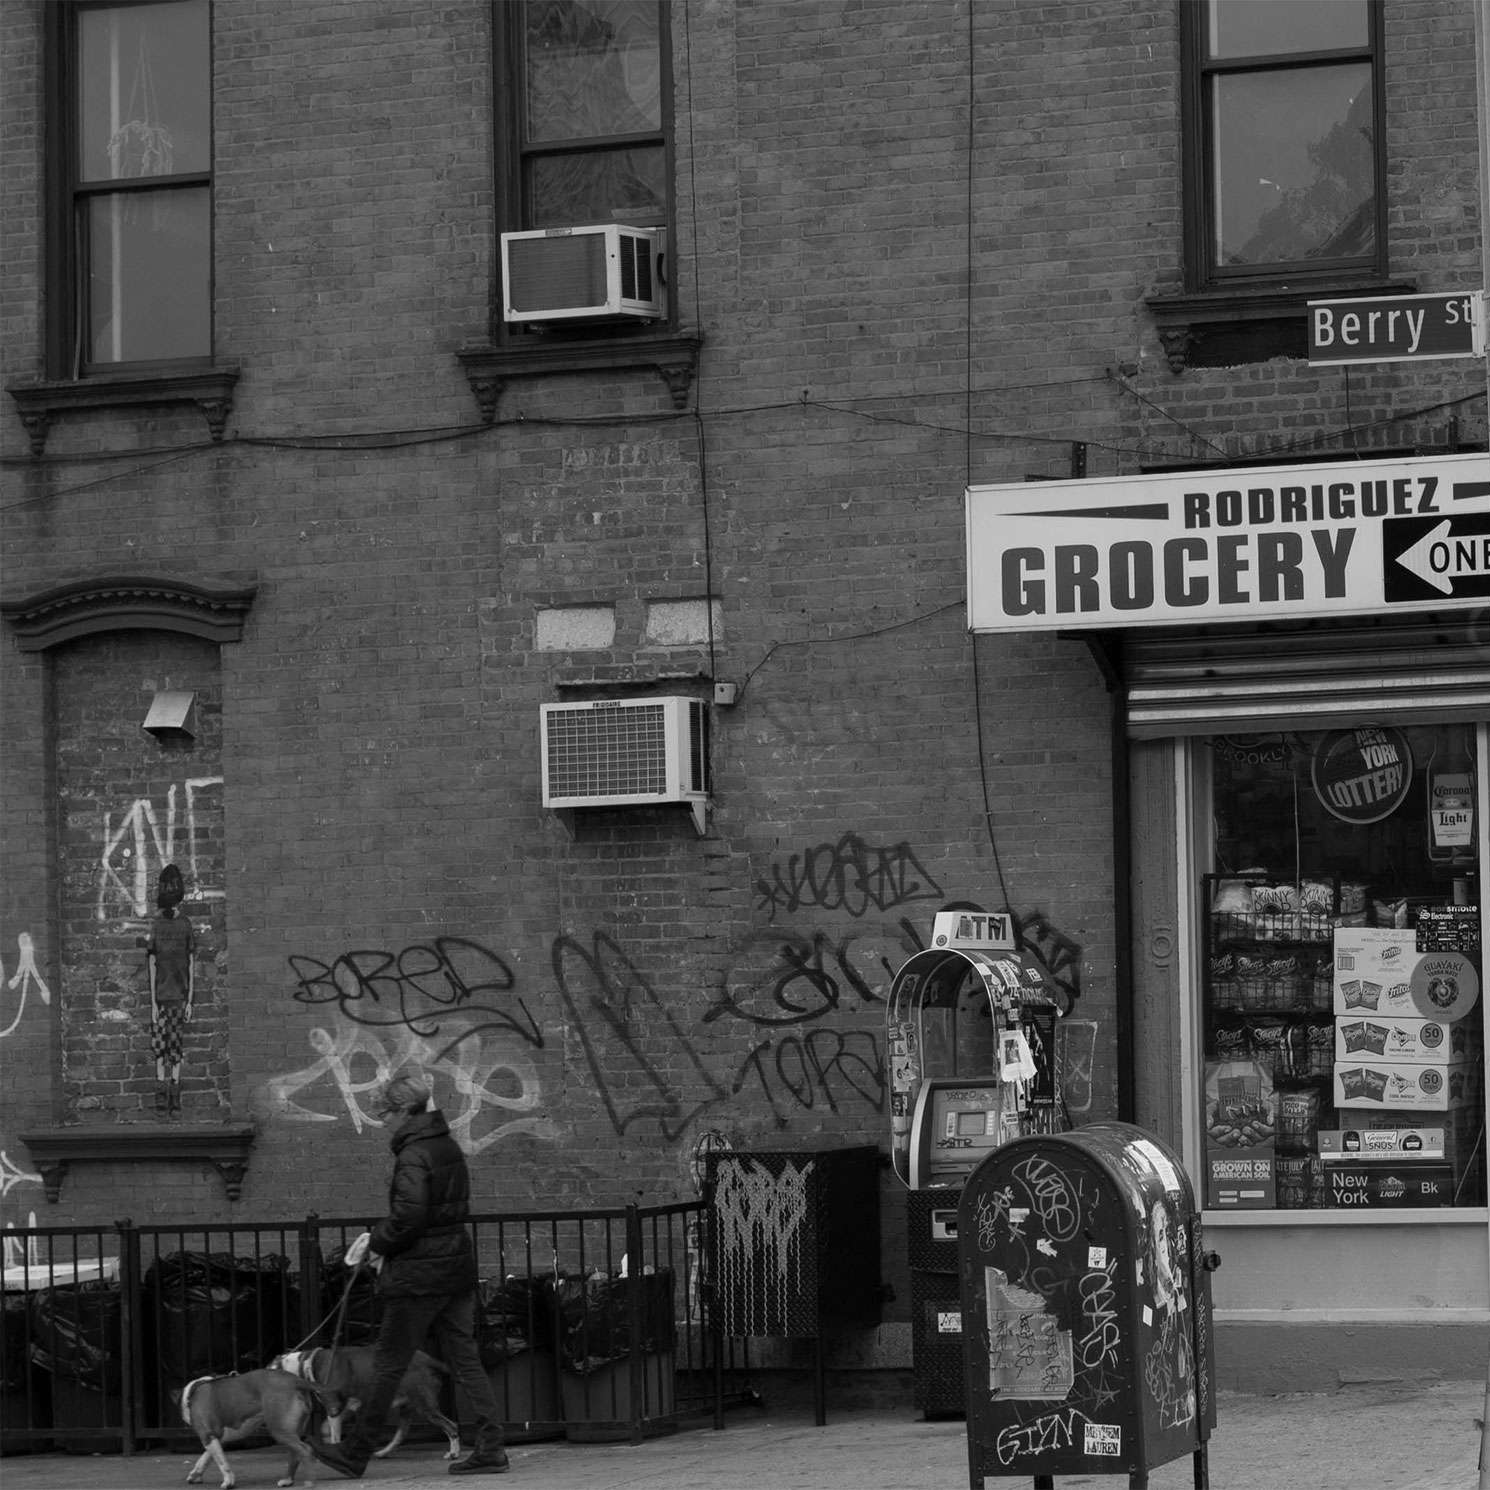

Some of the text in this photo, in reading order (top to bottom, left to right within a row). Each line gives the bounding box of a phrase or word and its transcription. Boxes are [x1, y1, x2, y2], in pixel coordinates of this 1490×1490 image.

[1314, 299, 1472, 353] Berry St
[1183, 476, 1440, 530] RODRIGUEZ
[1001, 527, 1357, 617] GROCERY
[1355, 729, 1388, 748] NEW
[1360, 744, 1399, 769] YORK
[1327, 763, 1402, 808] LOTTERY
[1434, 785, 1472, 798] Corona
[1439, 811, 1467, 826] Light
[1425, 1028, 1439, 1038] 50
[1424, 1074, 1438, 1084] 50
[1212, 1163, 1270, 1172] GROWN ON
[1289, 1161, 1305, 1173] JULY
[1332, 1172, 1368, 1188] New
[1421, 1182, 1438, 1194] Bk
[1332, 1189, 1370, 1204] York
[1086, 1441, 1119, 1454] LAUREN
